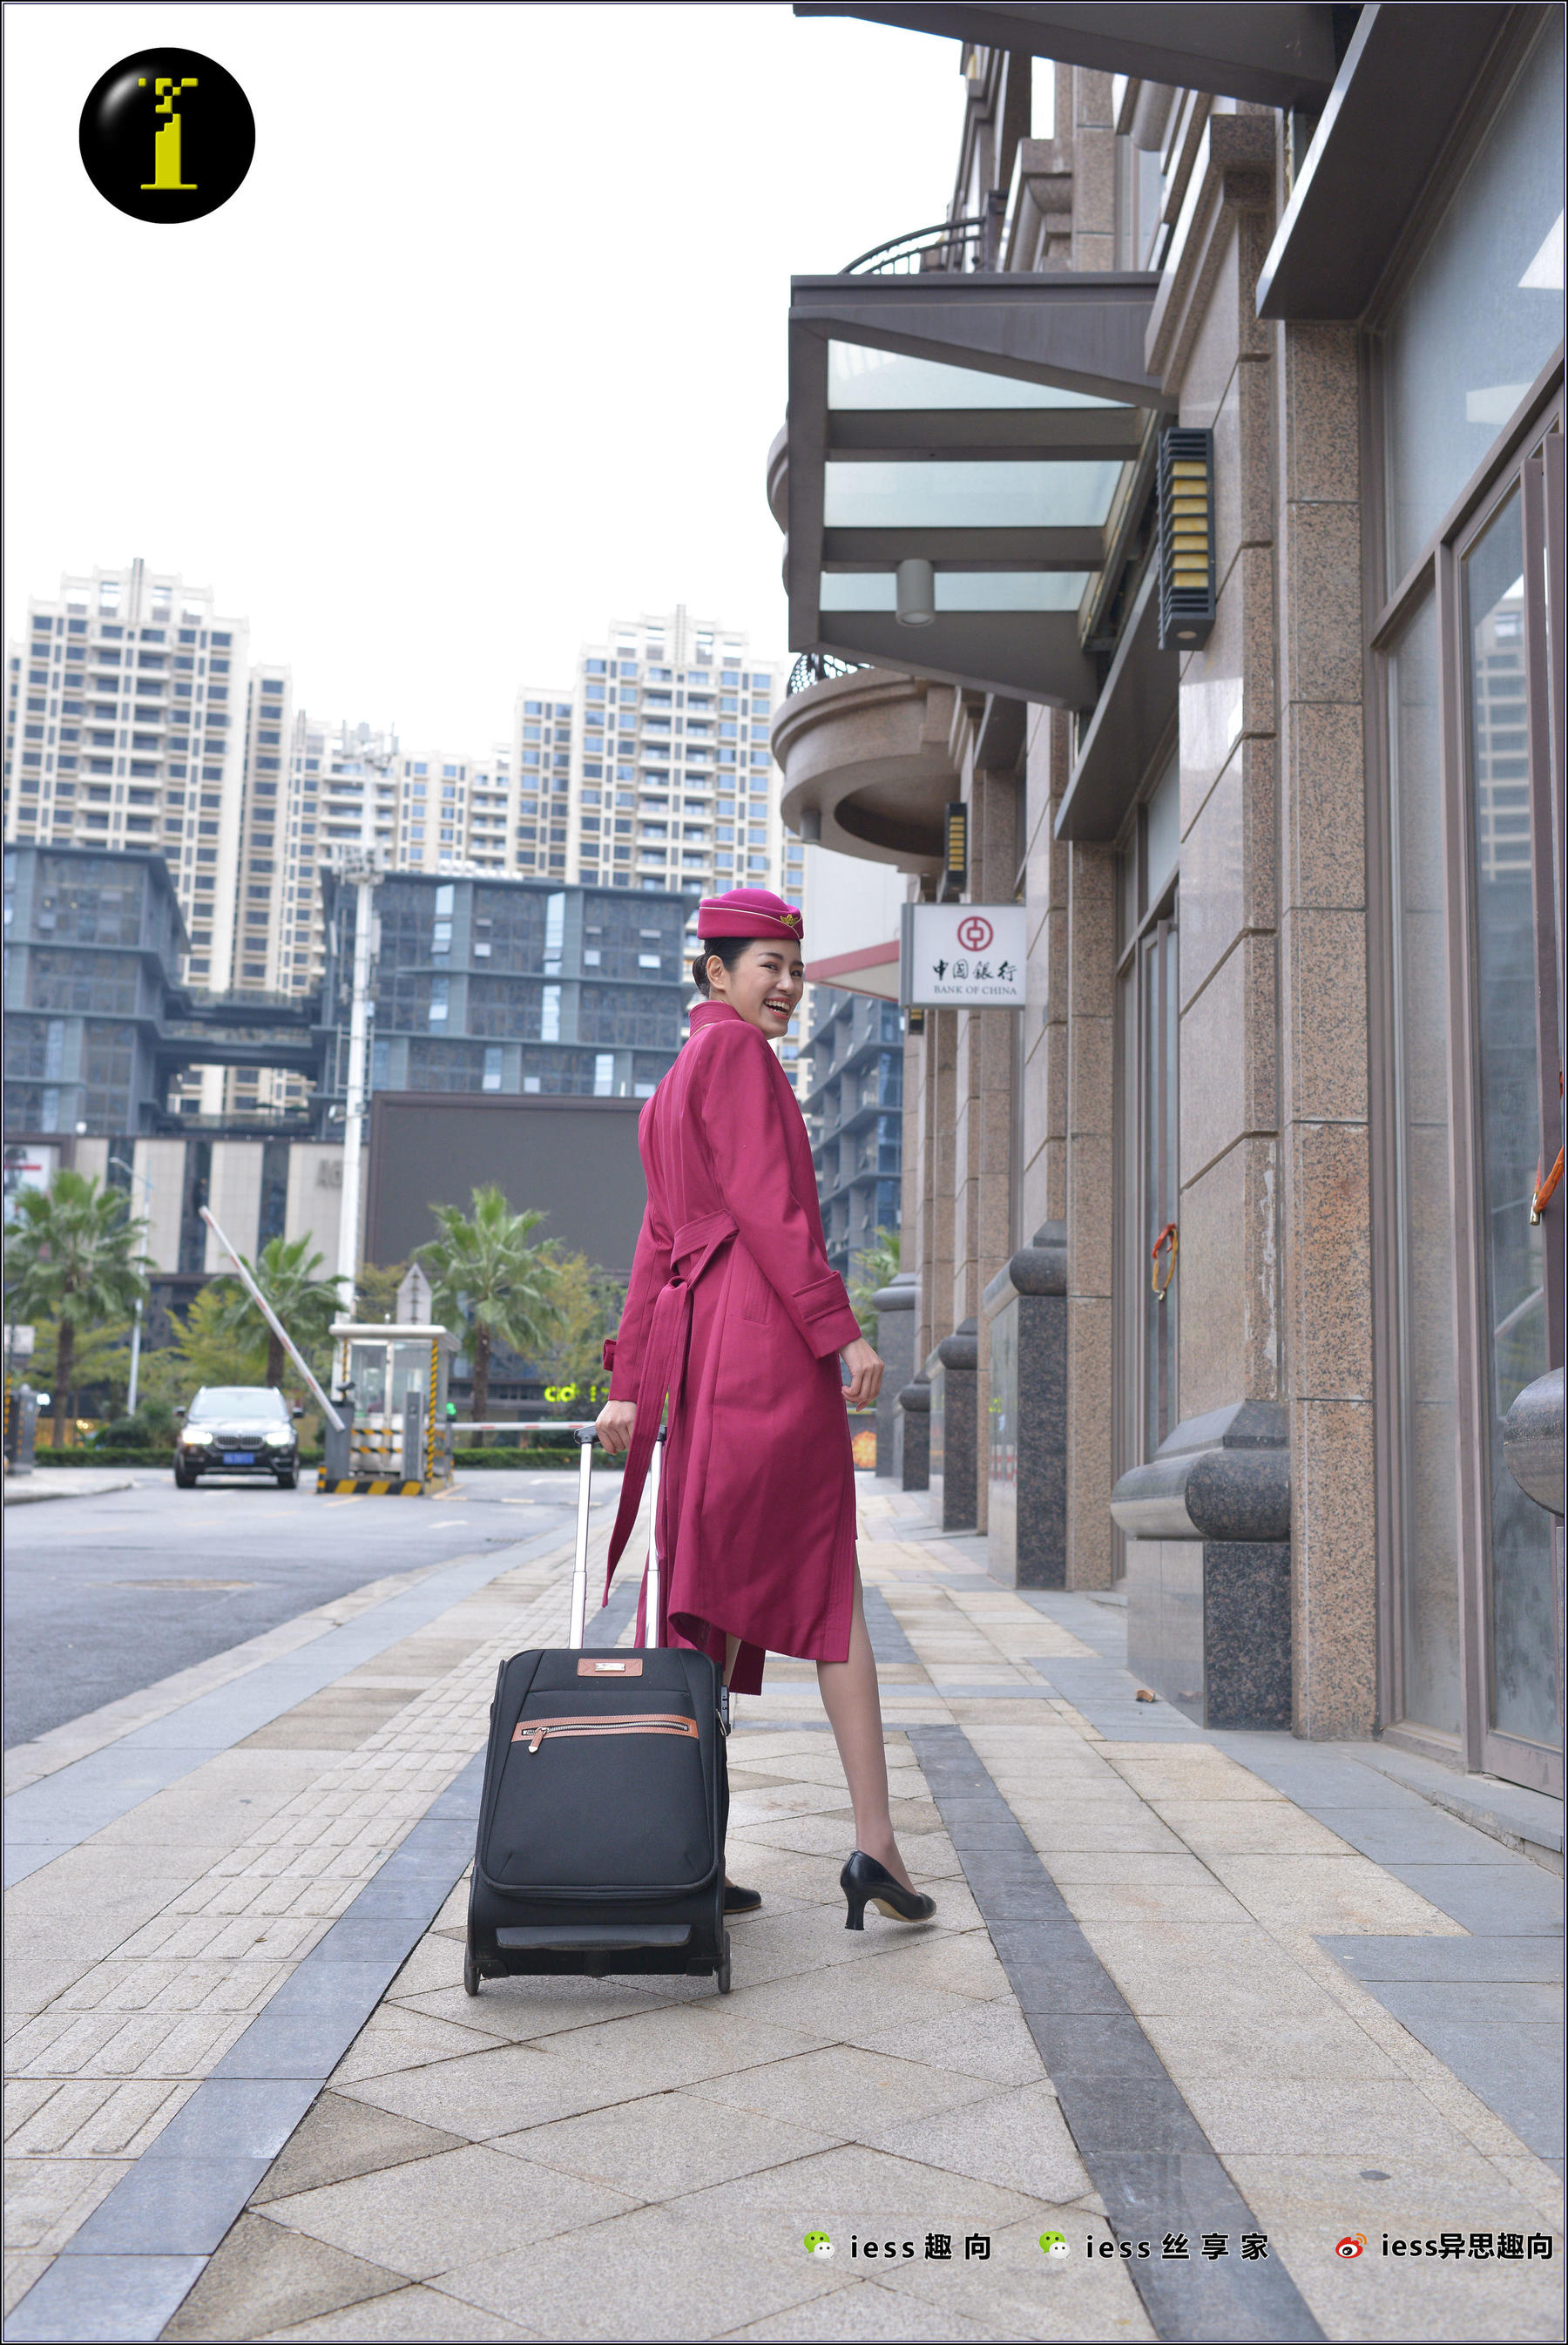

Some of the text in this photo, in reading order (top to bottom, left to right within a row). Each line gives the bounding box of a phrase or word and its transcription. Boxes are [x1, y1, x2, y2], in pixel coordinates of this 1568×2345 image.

[934, 984, 1017, 996] BANK OF CHINA
